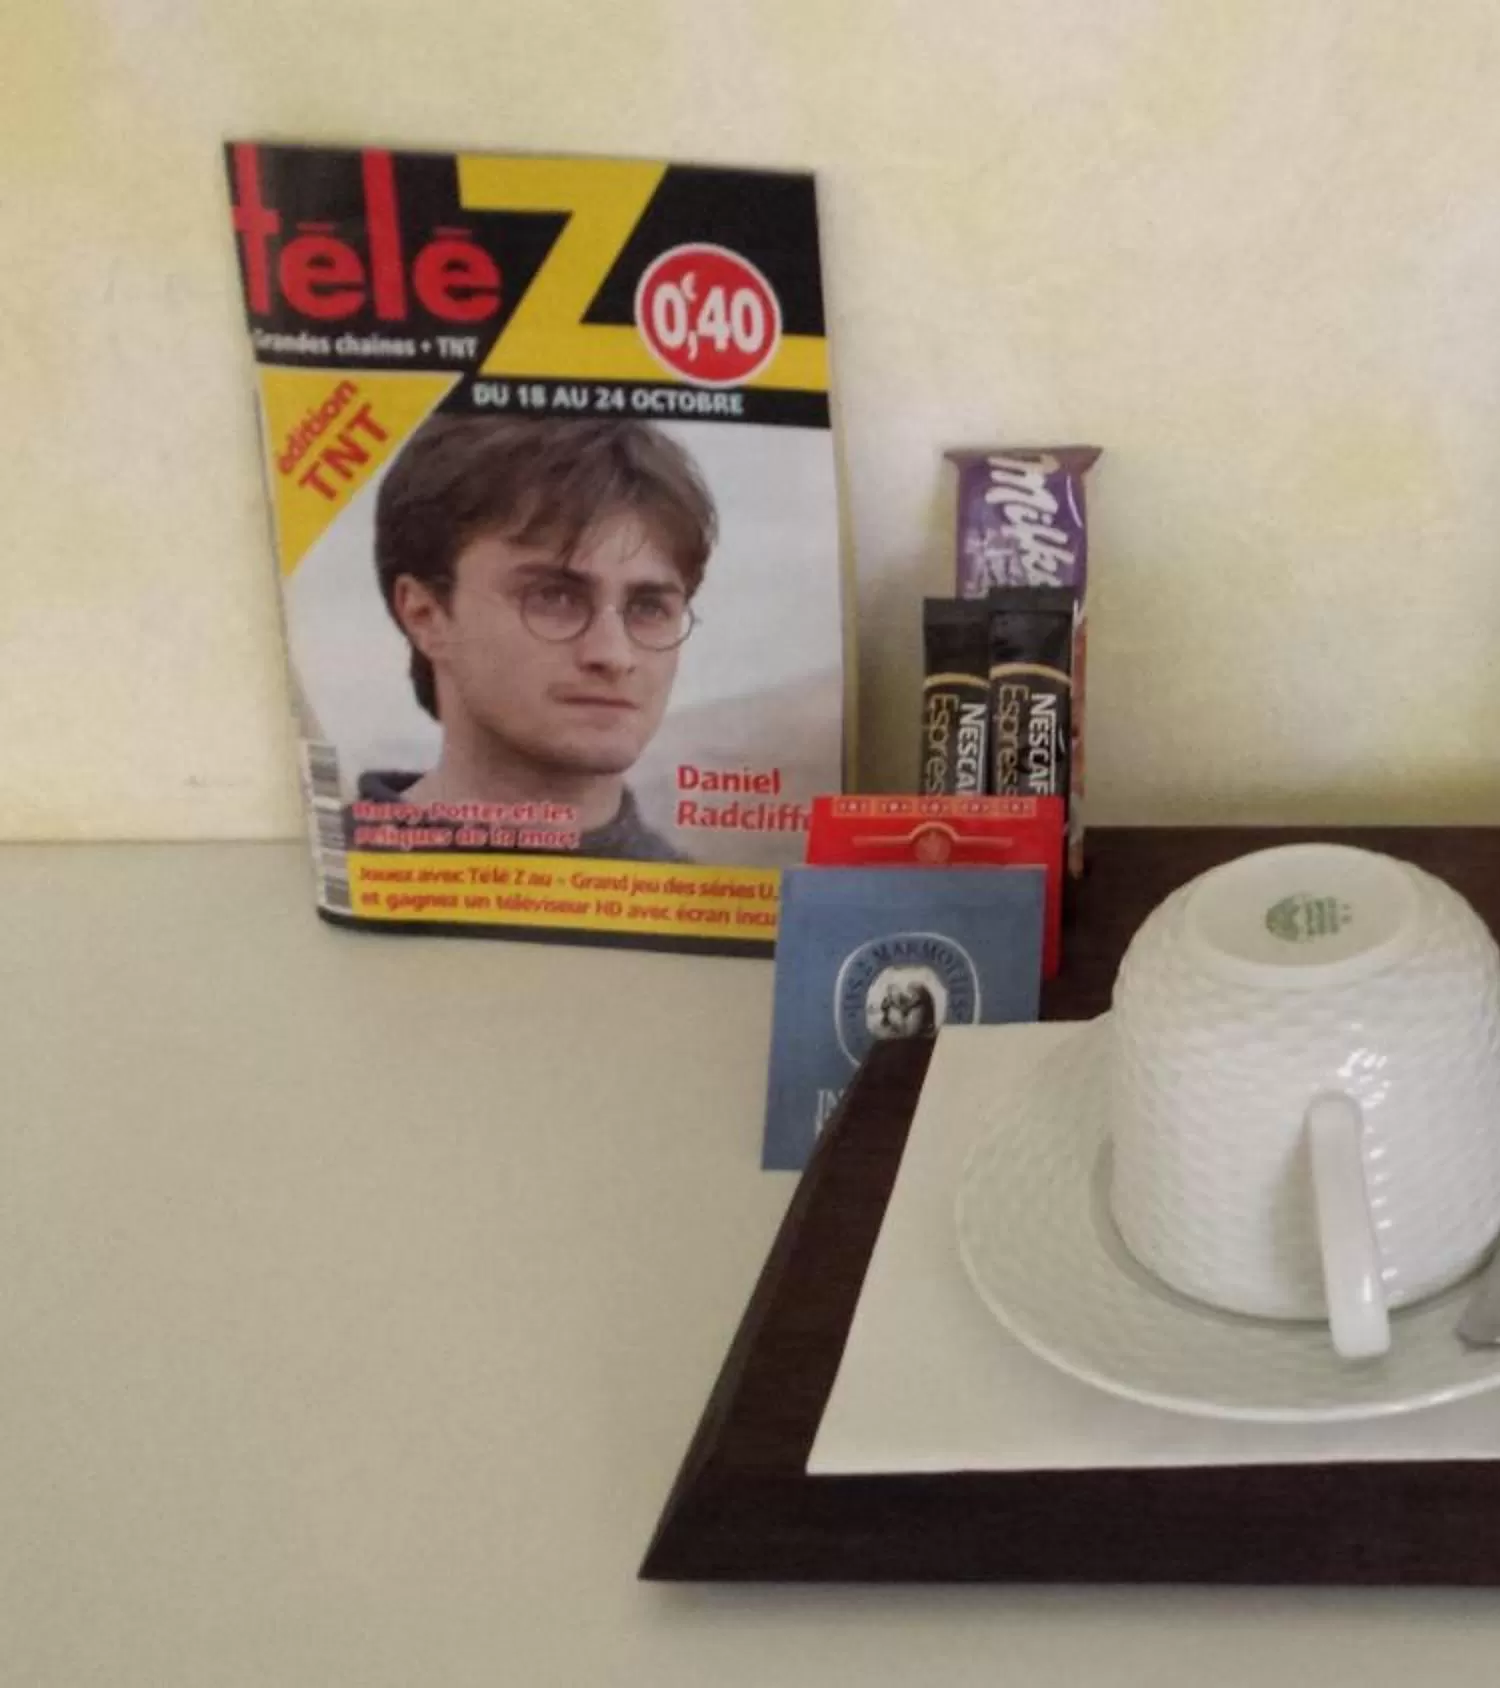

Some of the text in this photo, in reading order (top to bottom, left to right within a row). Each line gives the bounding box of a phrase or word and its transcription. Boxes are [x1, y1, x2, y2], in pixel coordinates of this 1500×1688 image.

[456, 154, 735, 391] Z
[435, 335, 479, 359] TNT
[472, 383, 510, 407] DU
[553, 386, 588, 409] AU
[594, 387, 626, 411] 24
[632, 389, 746, 416] OCTOBRE
[298, 401, 389, 502] TNT
[924, 693, 961, 797] Espres
[955, 703, 988, 796] NESCA
[997, 683, 1031, 796] Espres
[1027, 692, 1058, 796] NESCAF
[676, 763, 781, 796] Daniel
[427, 802, 506, 823] Potter
[517, 830, 580, 849] mort
[417, 868, 467, 884] avec
[570, 871, 630, 893] Grand
[630, 876, 660, 897] jeu
[663, 876, 697, 896] des
[463, 895, 491, 909] un
[627, 904, 672, 921] avec
[734, 908, 778, 927] incu
